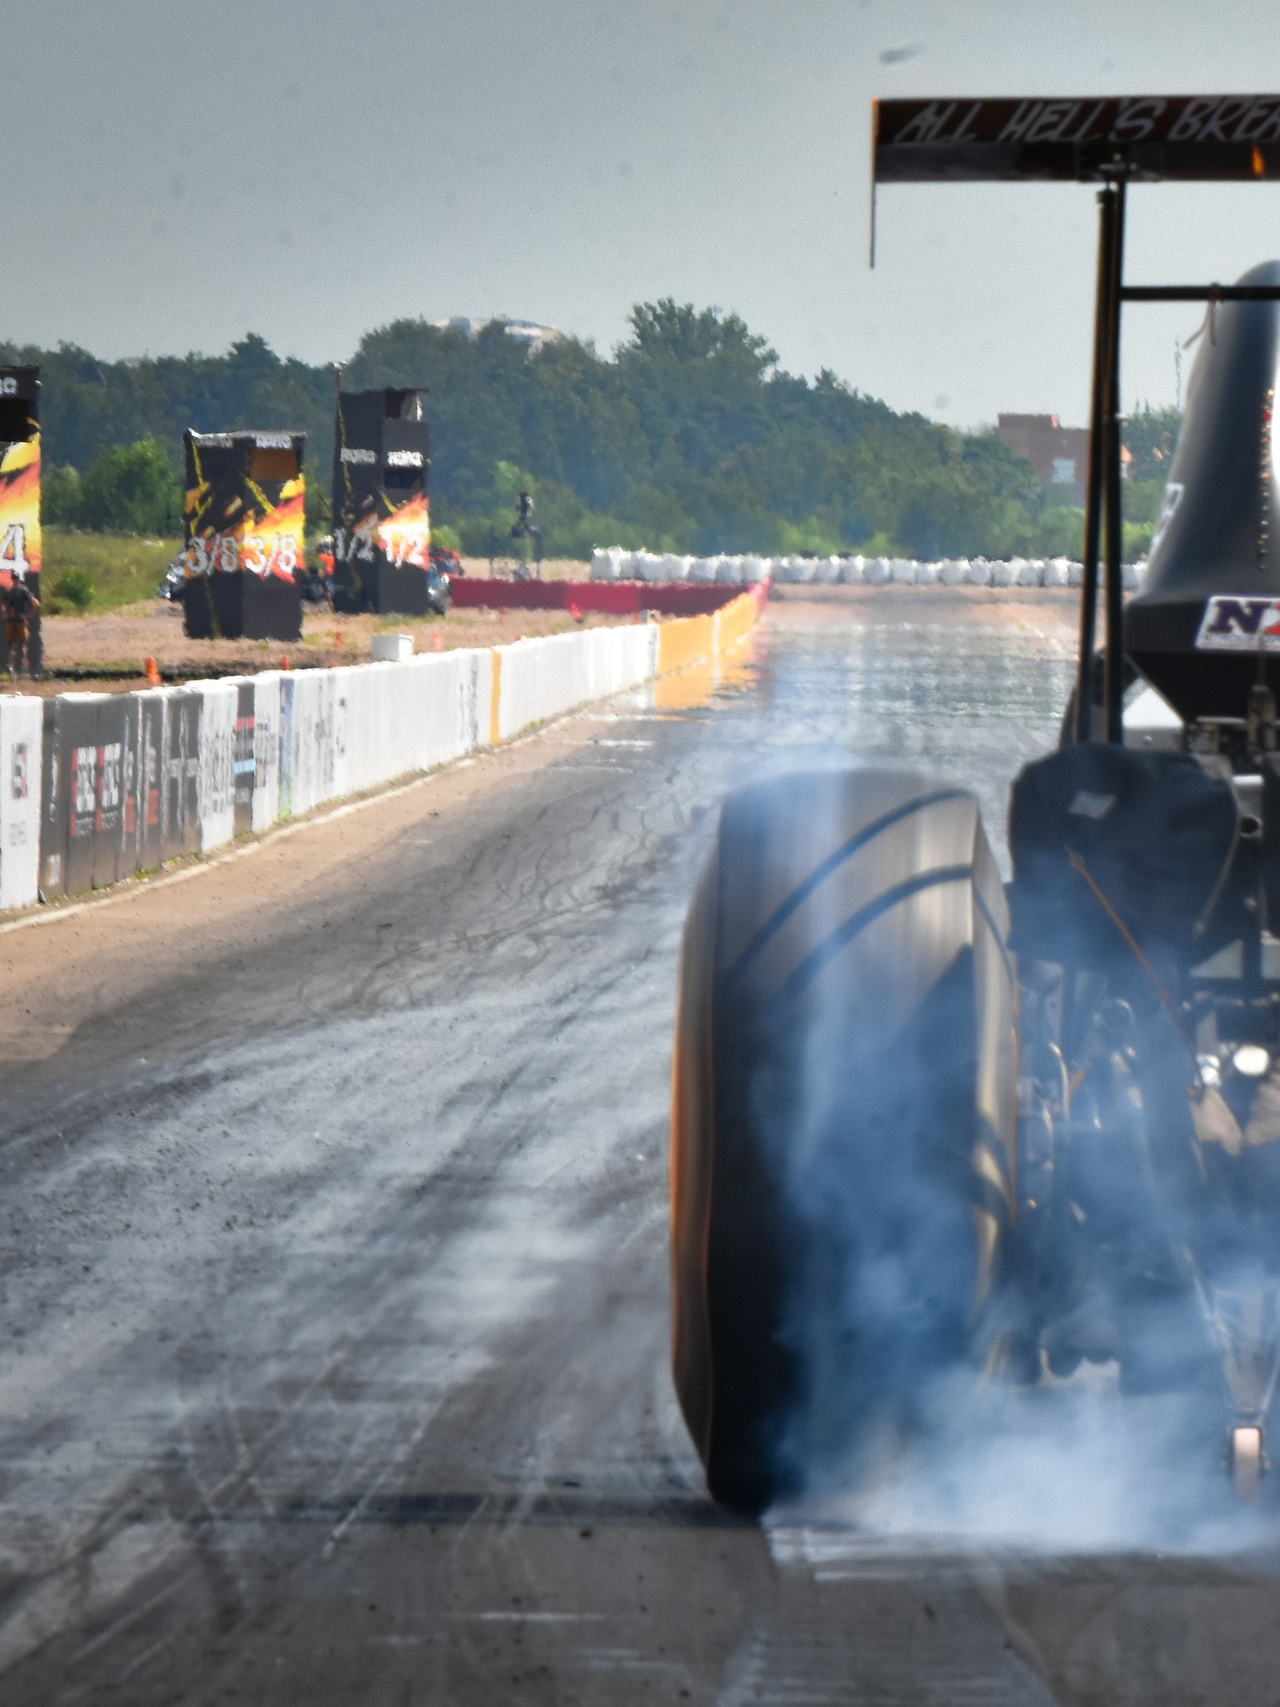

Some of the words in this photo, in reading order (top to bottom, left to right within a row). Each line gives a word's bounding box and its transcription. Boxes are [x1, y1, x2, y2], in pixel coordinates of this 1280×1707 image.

[893, 101, 982, 143] ALL
[996, 98, 1168, 143] HELL'S
[187, 533, 238, 577] 3/8
[244, 532, 298, 577] 3/8
